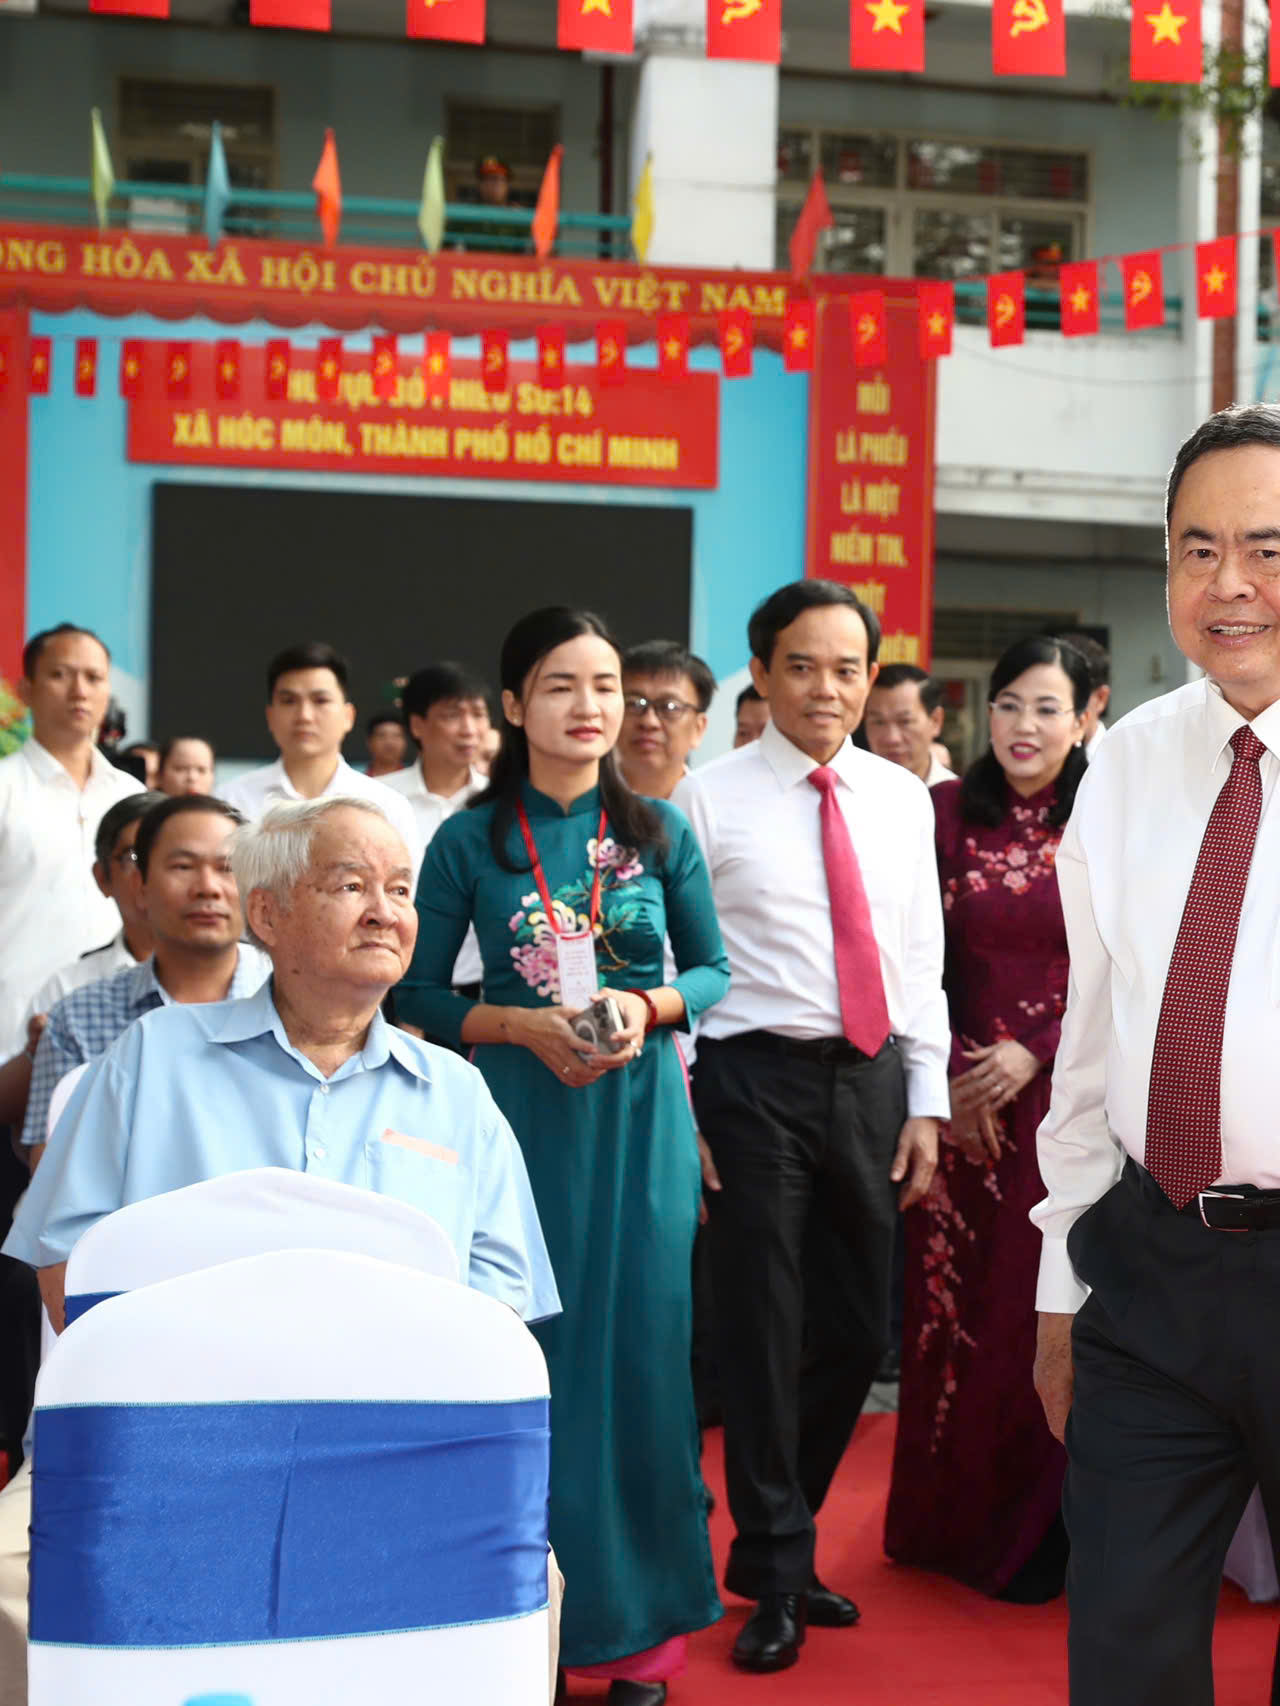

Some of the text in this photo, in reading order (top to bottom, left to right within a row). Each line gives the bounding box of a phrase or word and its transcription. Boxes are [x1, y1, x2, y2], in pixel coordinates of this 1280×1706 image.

[0, 236, 787, 317] NG HÒA XÃ HỘI CHỦ NGHĨA VIỆT NAM
[173, 408, 679, 471] XÃ HÓC MÔN, THÀNH PHỐ HỒ CHÍ MINH
